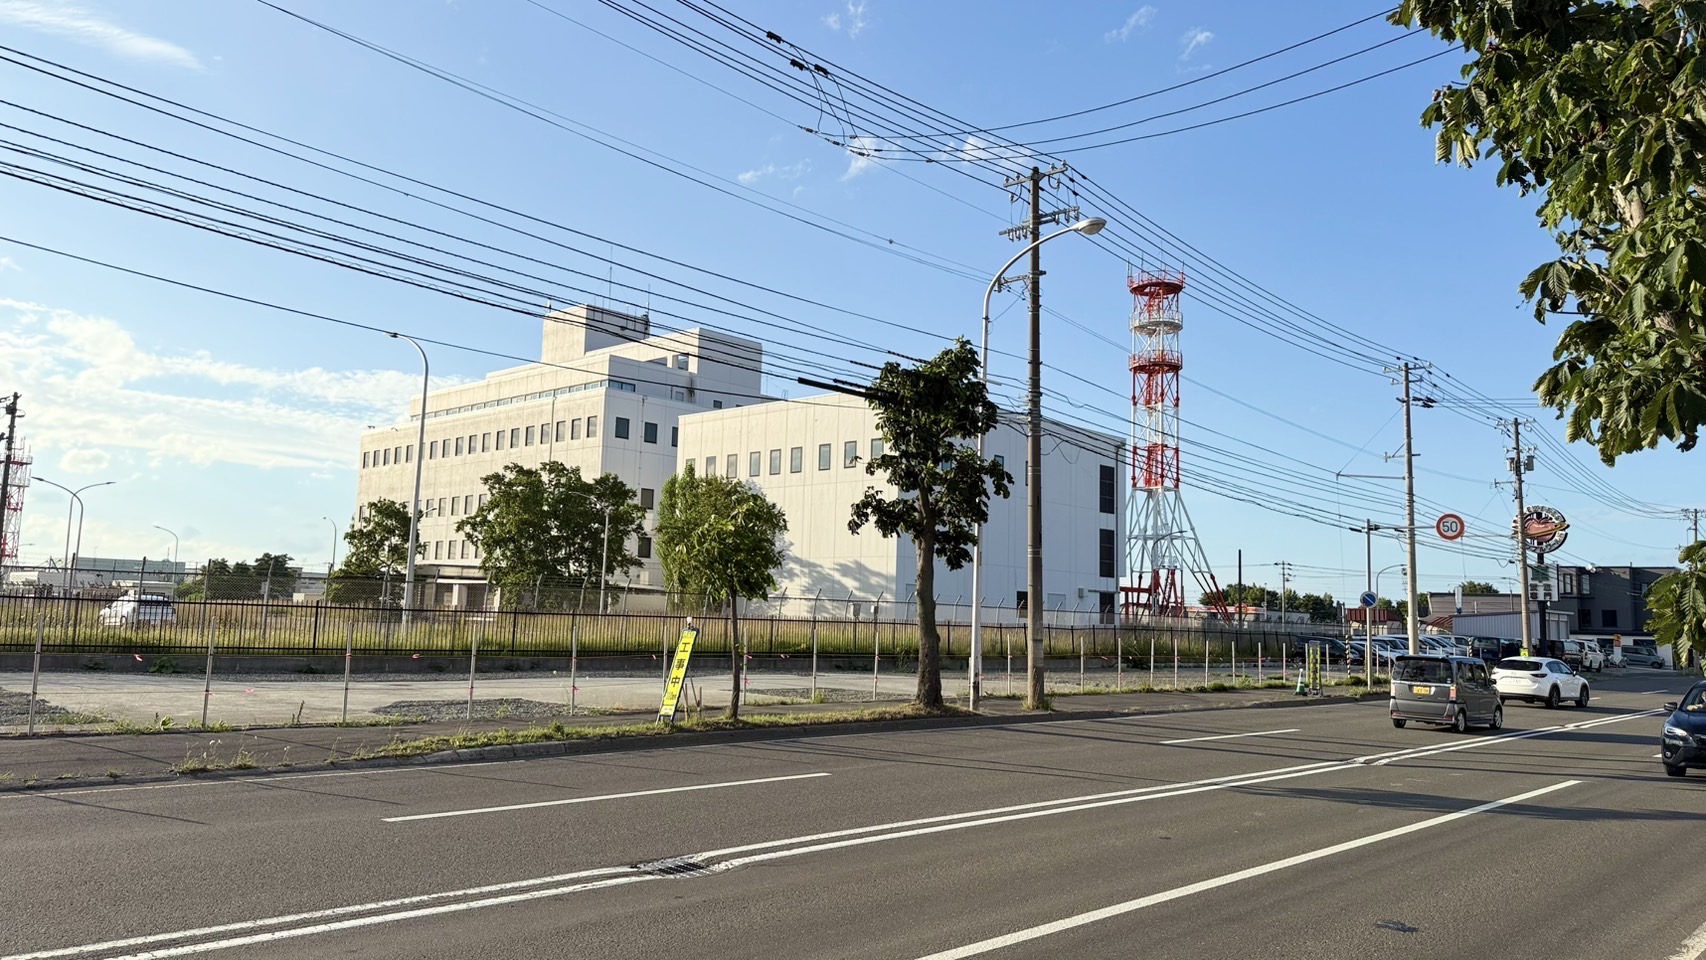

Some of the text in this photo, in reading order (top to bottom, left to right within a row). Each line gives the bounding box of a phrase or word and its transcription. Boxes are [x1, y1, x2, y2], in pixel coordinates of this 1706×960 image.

[1442, 521, 1458, 532] 50
[671, 642, 690, 687] 工事中
